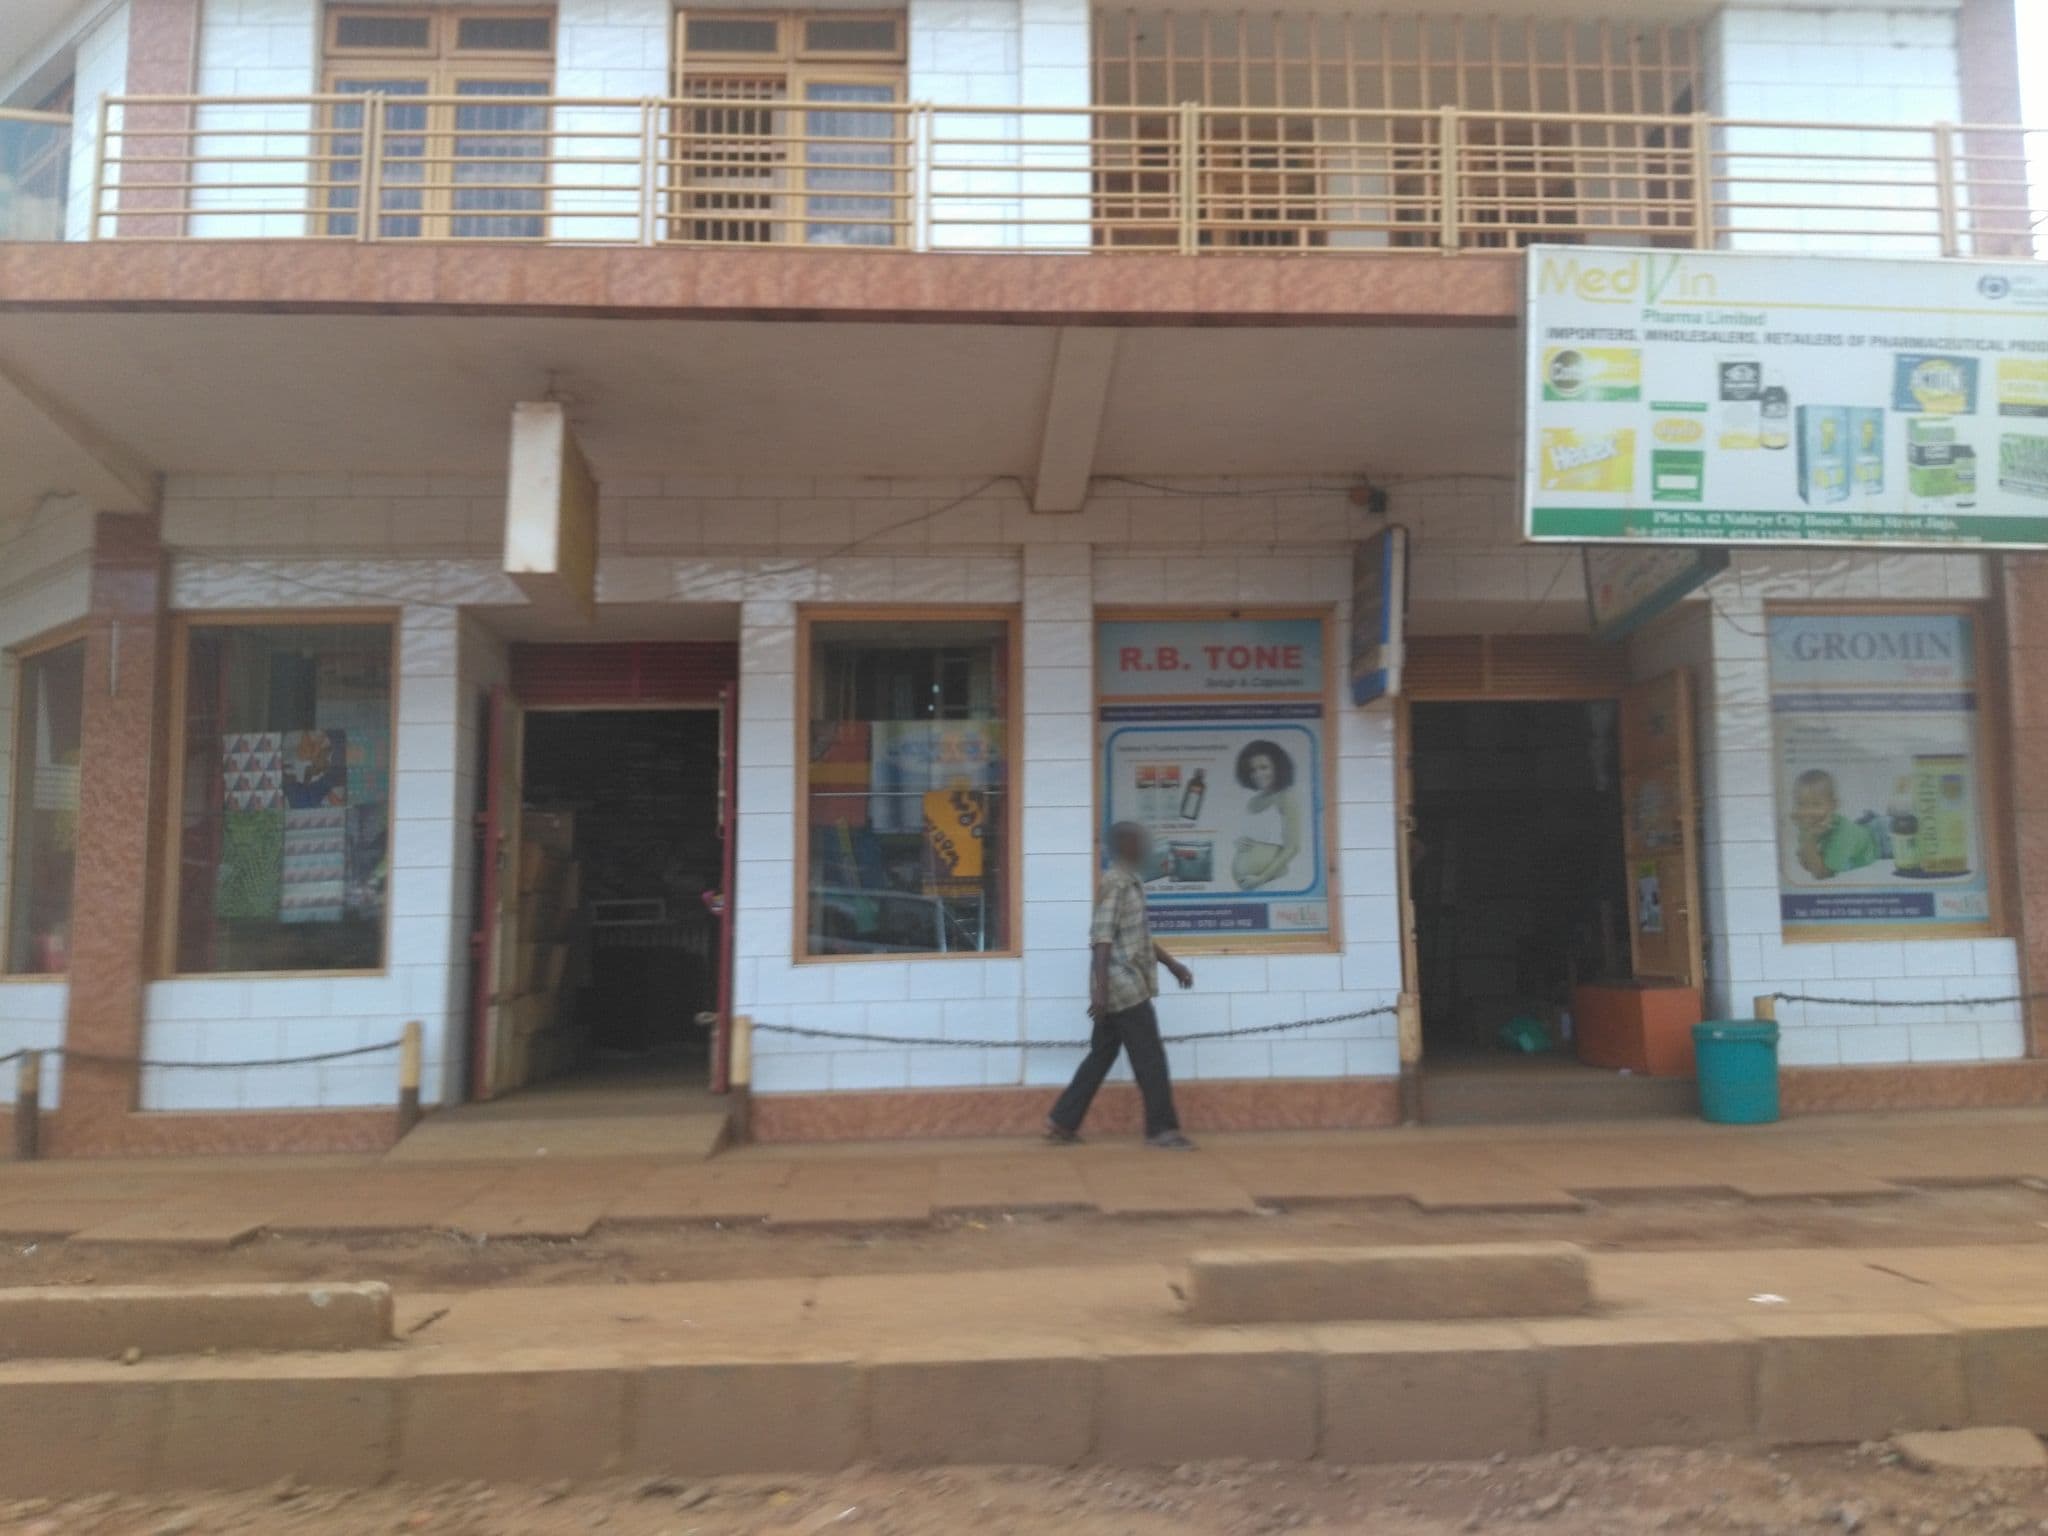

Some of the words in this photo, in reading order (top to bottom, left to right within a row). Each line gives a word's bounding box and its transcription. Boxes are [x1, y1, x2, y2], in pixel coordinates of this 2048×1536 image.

[1642, 308, 1702, 325] Pharma
[1706, 311, 1767, 326] Limited
[1847, 334, 1867, 347] OF
[1870, 335, 2005, 351] PHARMACEUTICAL
[1792, 631, 1950, 662] GROMIN
[1119, 646, 1191, 671] R.B.
[1204, 645, 1304, 670] TONE
